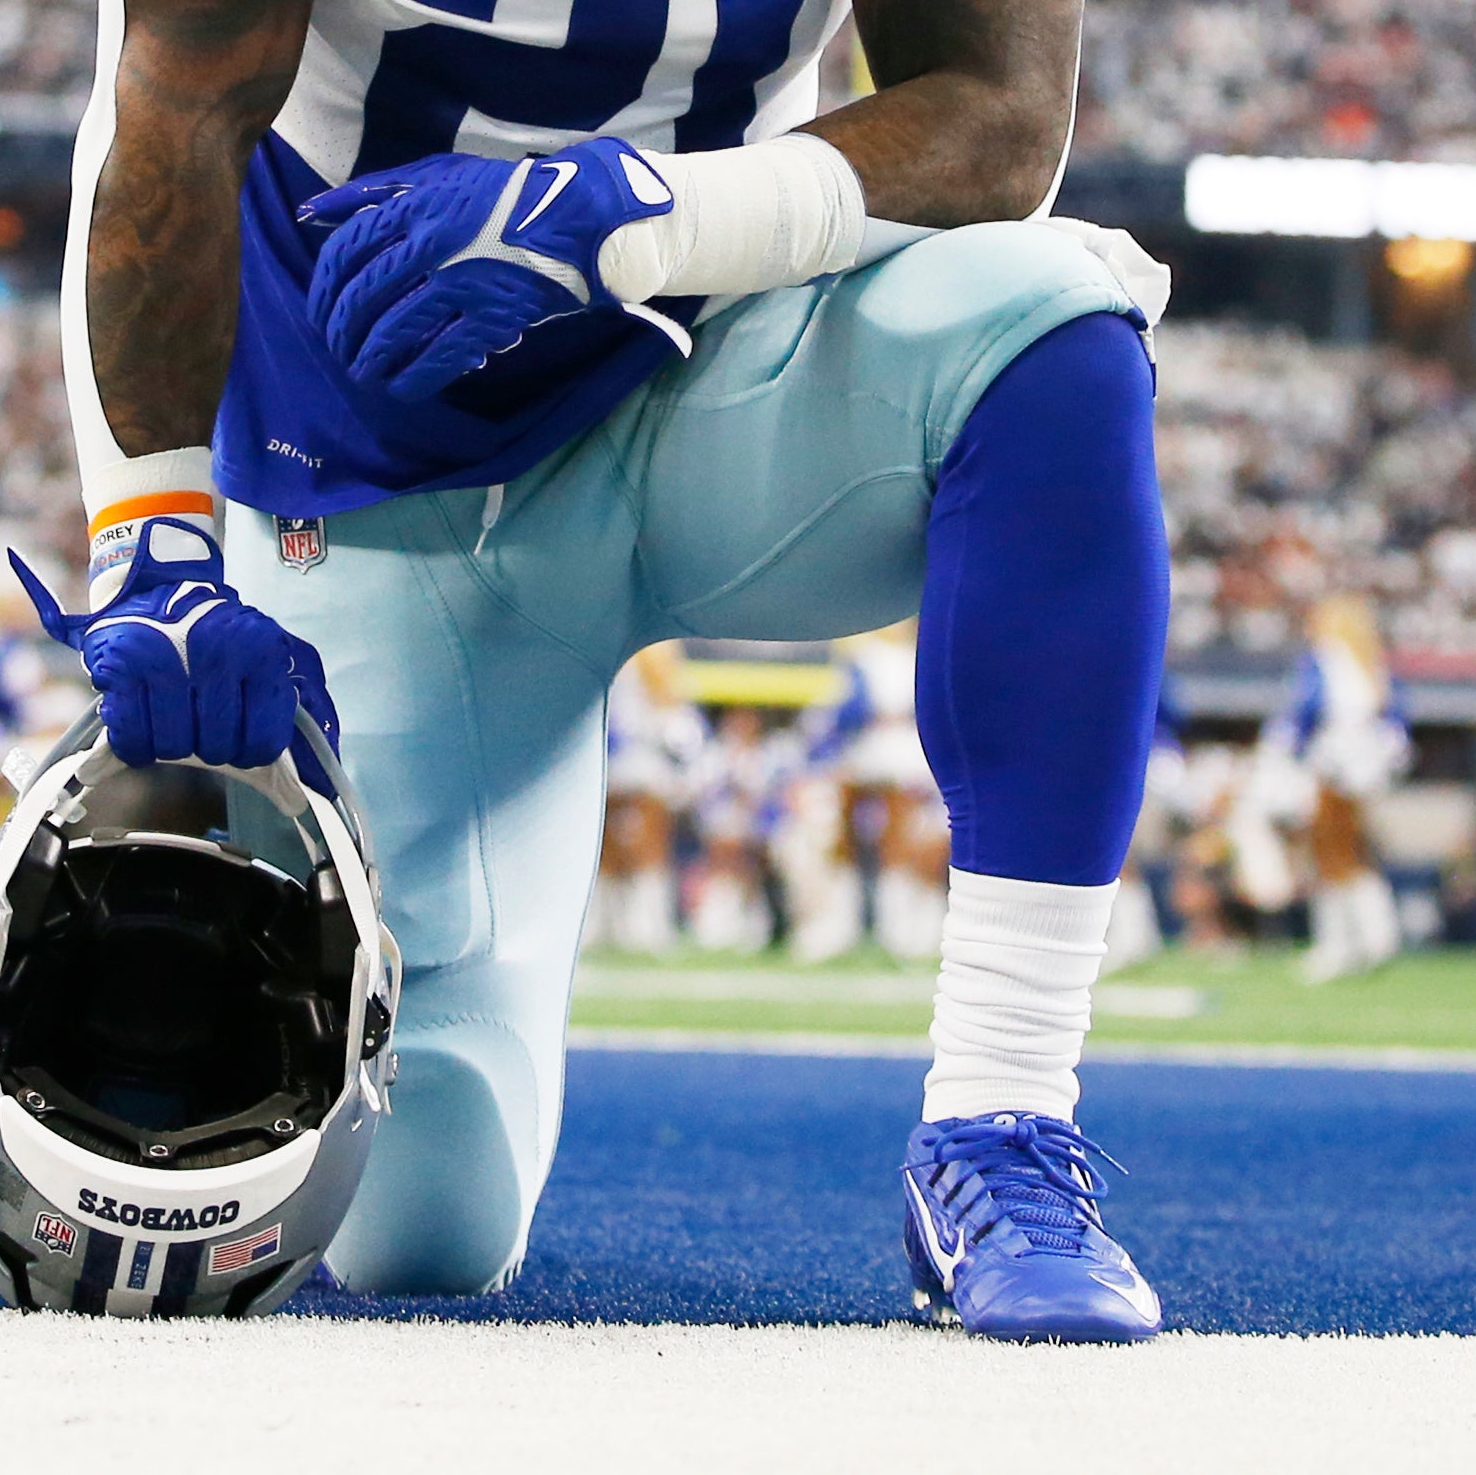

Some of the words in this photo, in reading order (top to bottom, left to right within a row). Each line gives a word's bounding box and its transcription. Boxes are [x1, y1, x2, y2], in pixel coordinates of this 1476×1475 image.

[283, 532, 318, 559] NFL
[78, 1188, 240, 1231] COWBOYS
[41, 1216, 75, 1242] NFL
